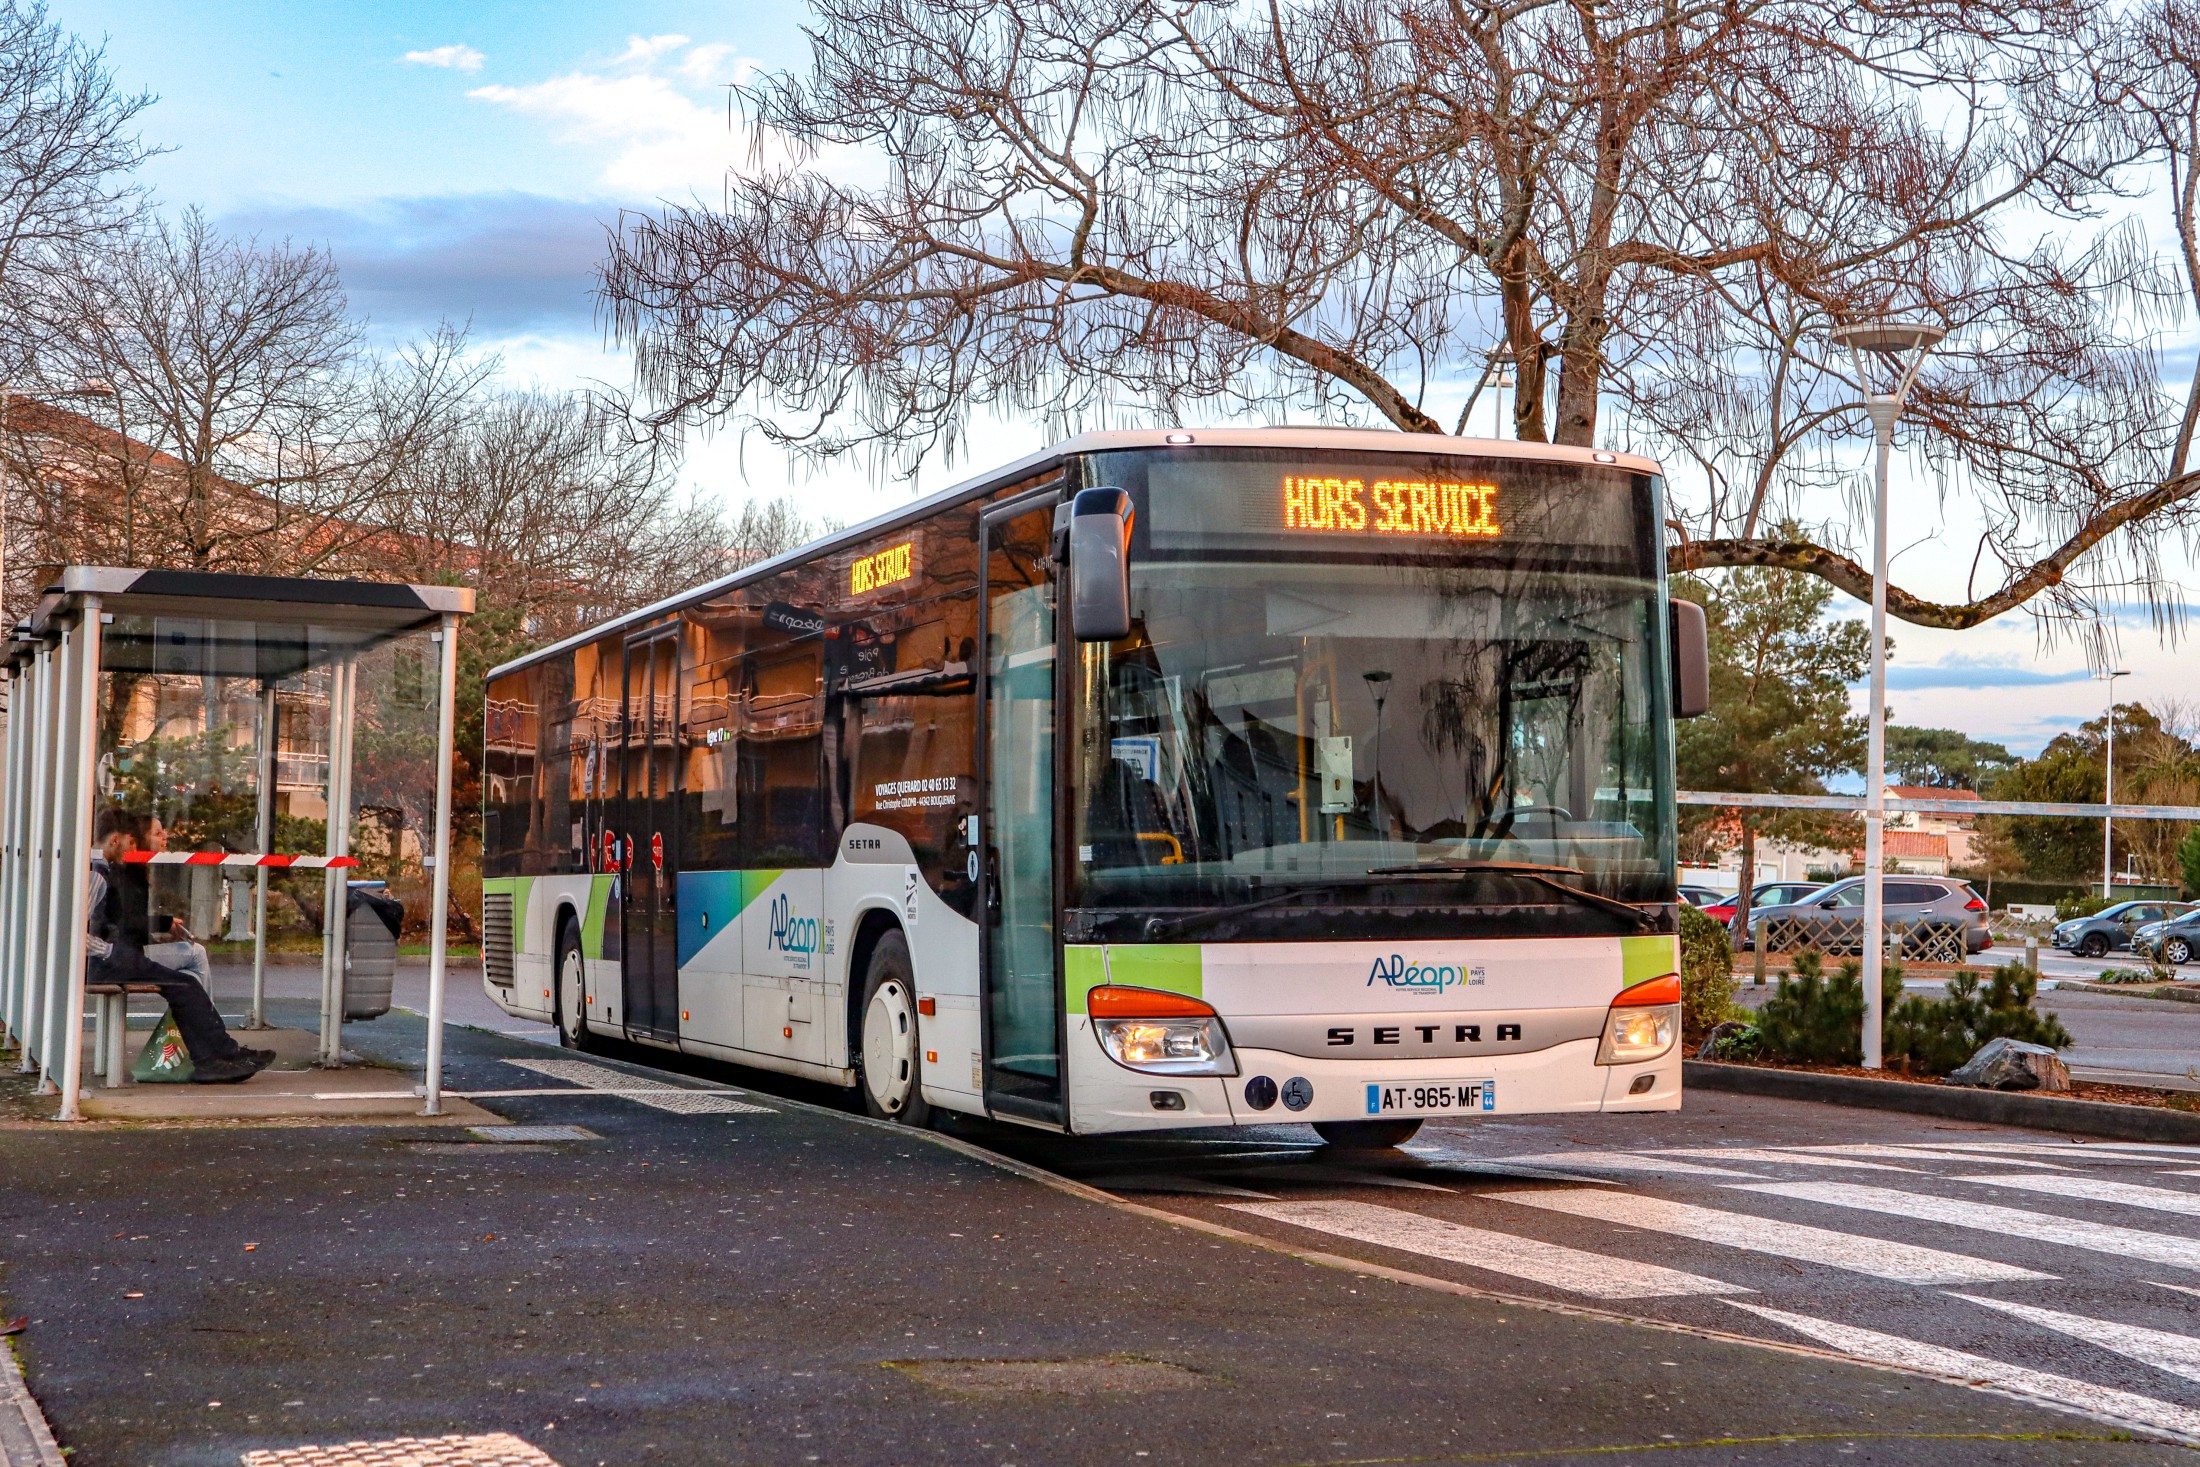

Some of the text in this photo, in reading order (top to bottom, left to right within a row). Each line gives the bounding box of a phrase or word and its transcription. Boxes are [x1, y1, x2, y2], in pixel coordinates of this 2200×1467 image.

[1285, 476, 1501, 536] HORS SERVICE
[851, 542, 912, 596] HORS SERVICE
[875, 776, 956, 797] VOYAGES QUERARD 02 40 65 13 32
[849, 839, 881, 849] SETRA
[1327, 1023, 1522, 1046] SETRA
[1382, 1086, 1482, 1109] AT-965-MF
[1484, 1096, 1493, 1107] 44
